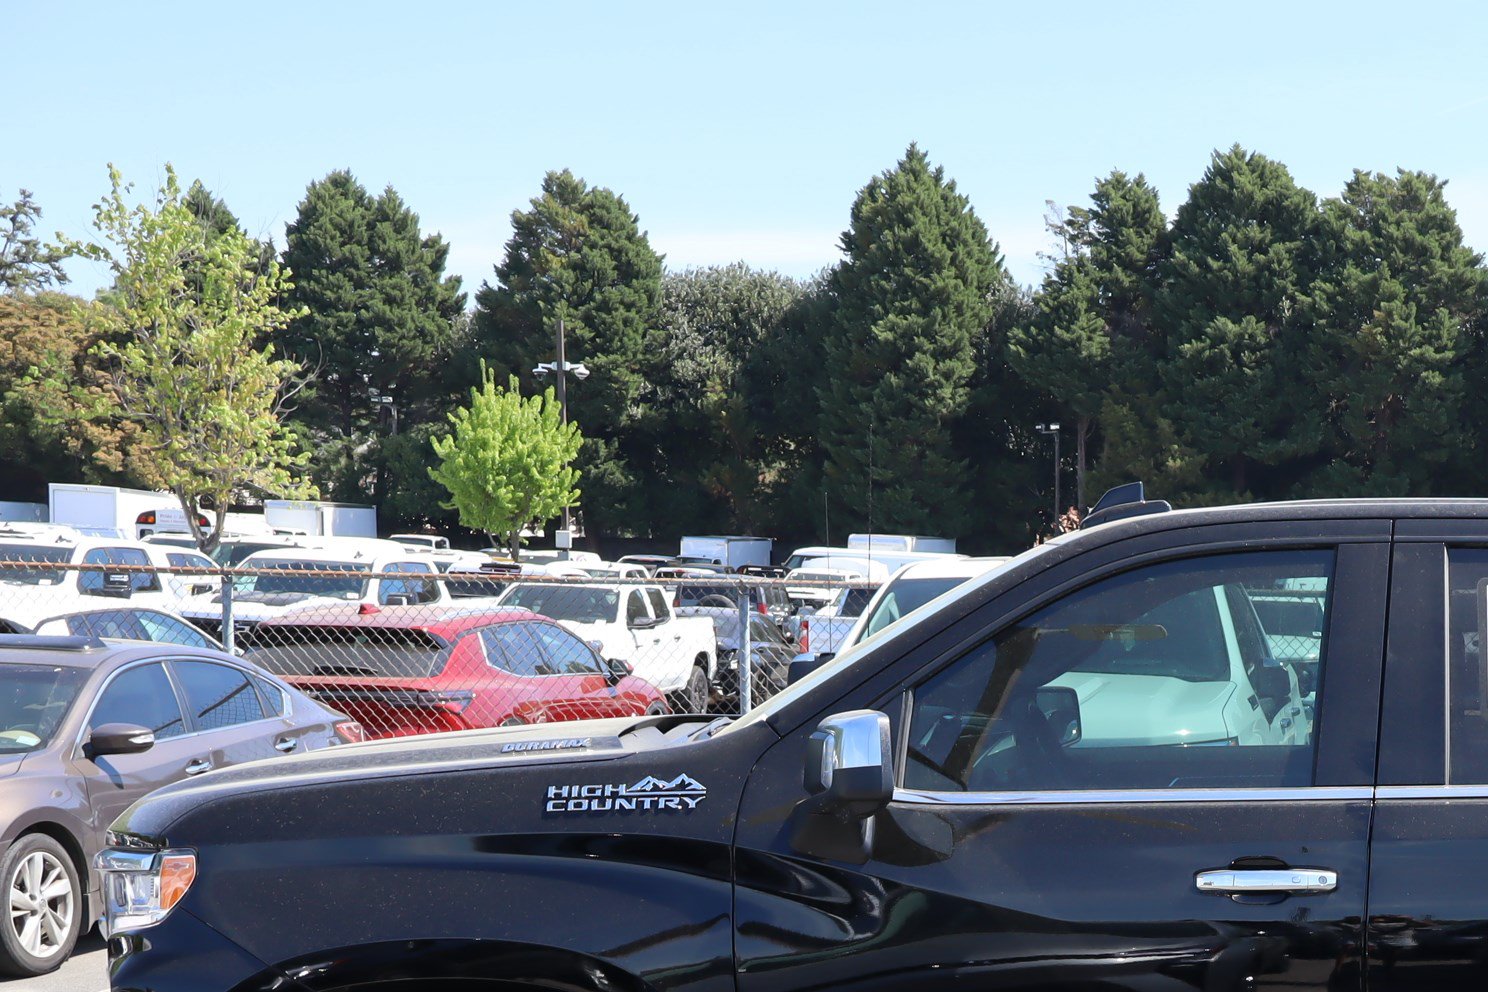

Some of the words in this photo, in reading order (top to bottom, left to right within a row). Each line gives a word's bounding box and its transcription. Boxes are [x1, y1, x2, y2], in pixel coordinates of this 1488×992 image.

[501, 737, 592, 753] DURAMAX
[547, 783, 627, 798] HIGH
[546, 796, 706, 812] COUNTRY
